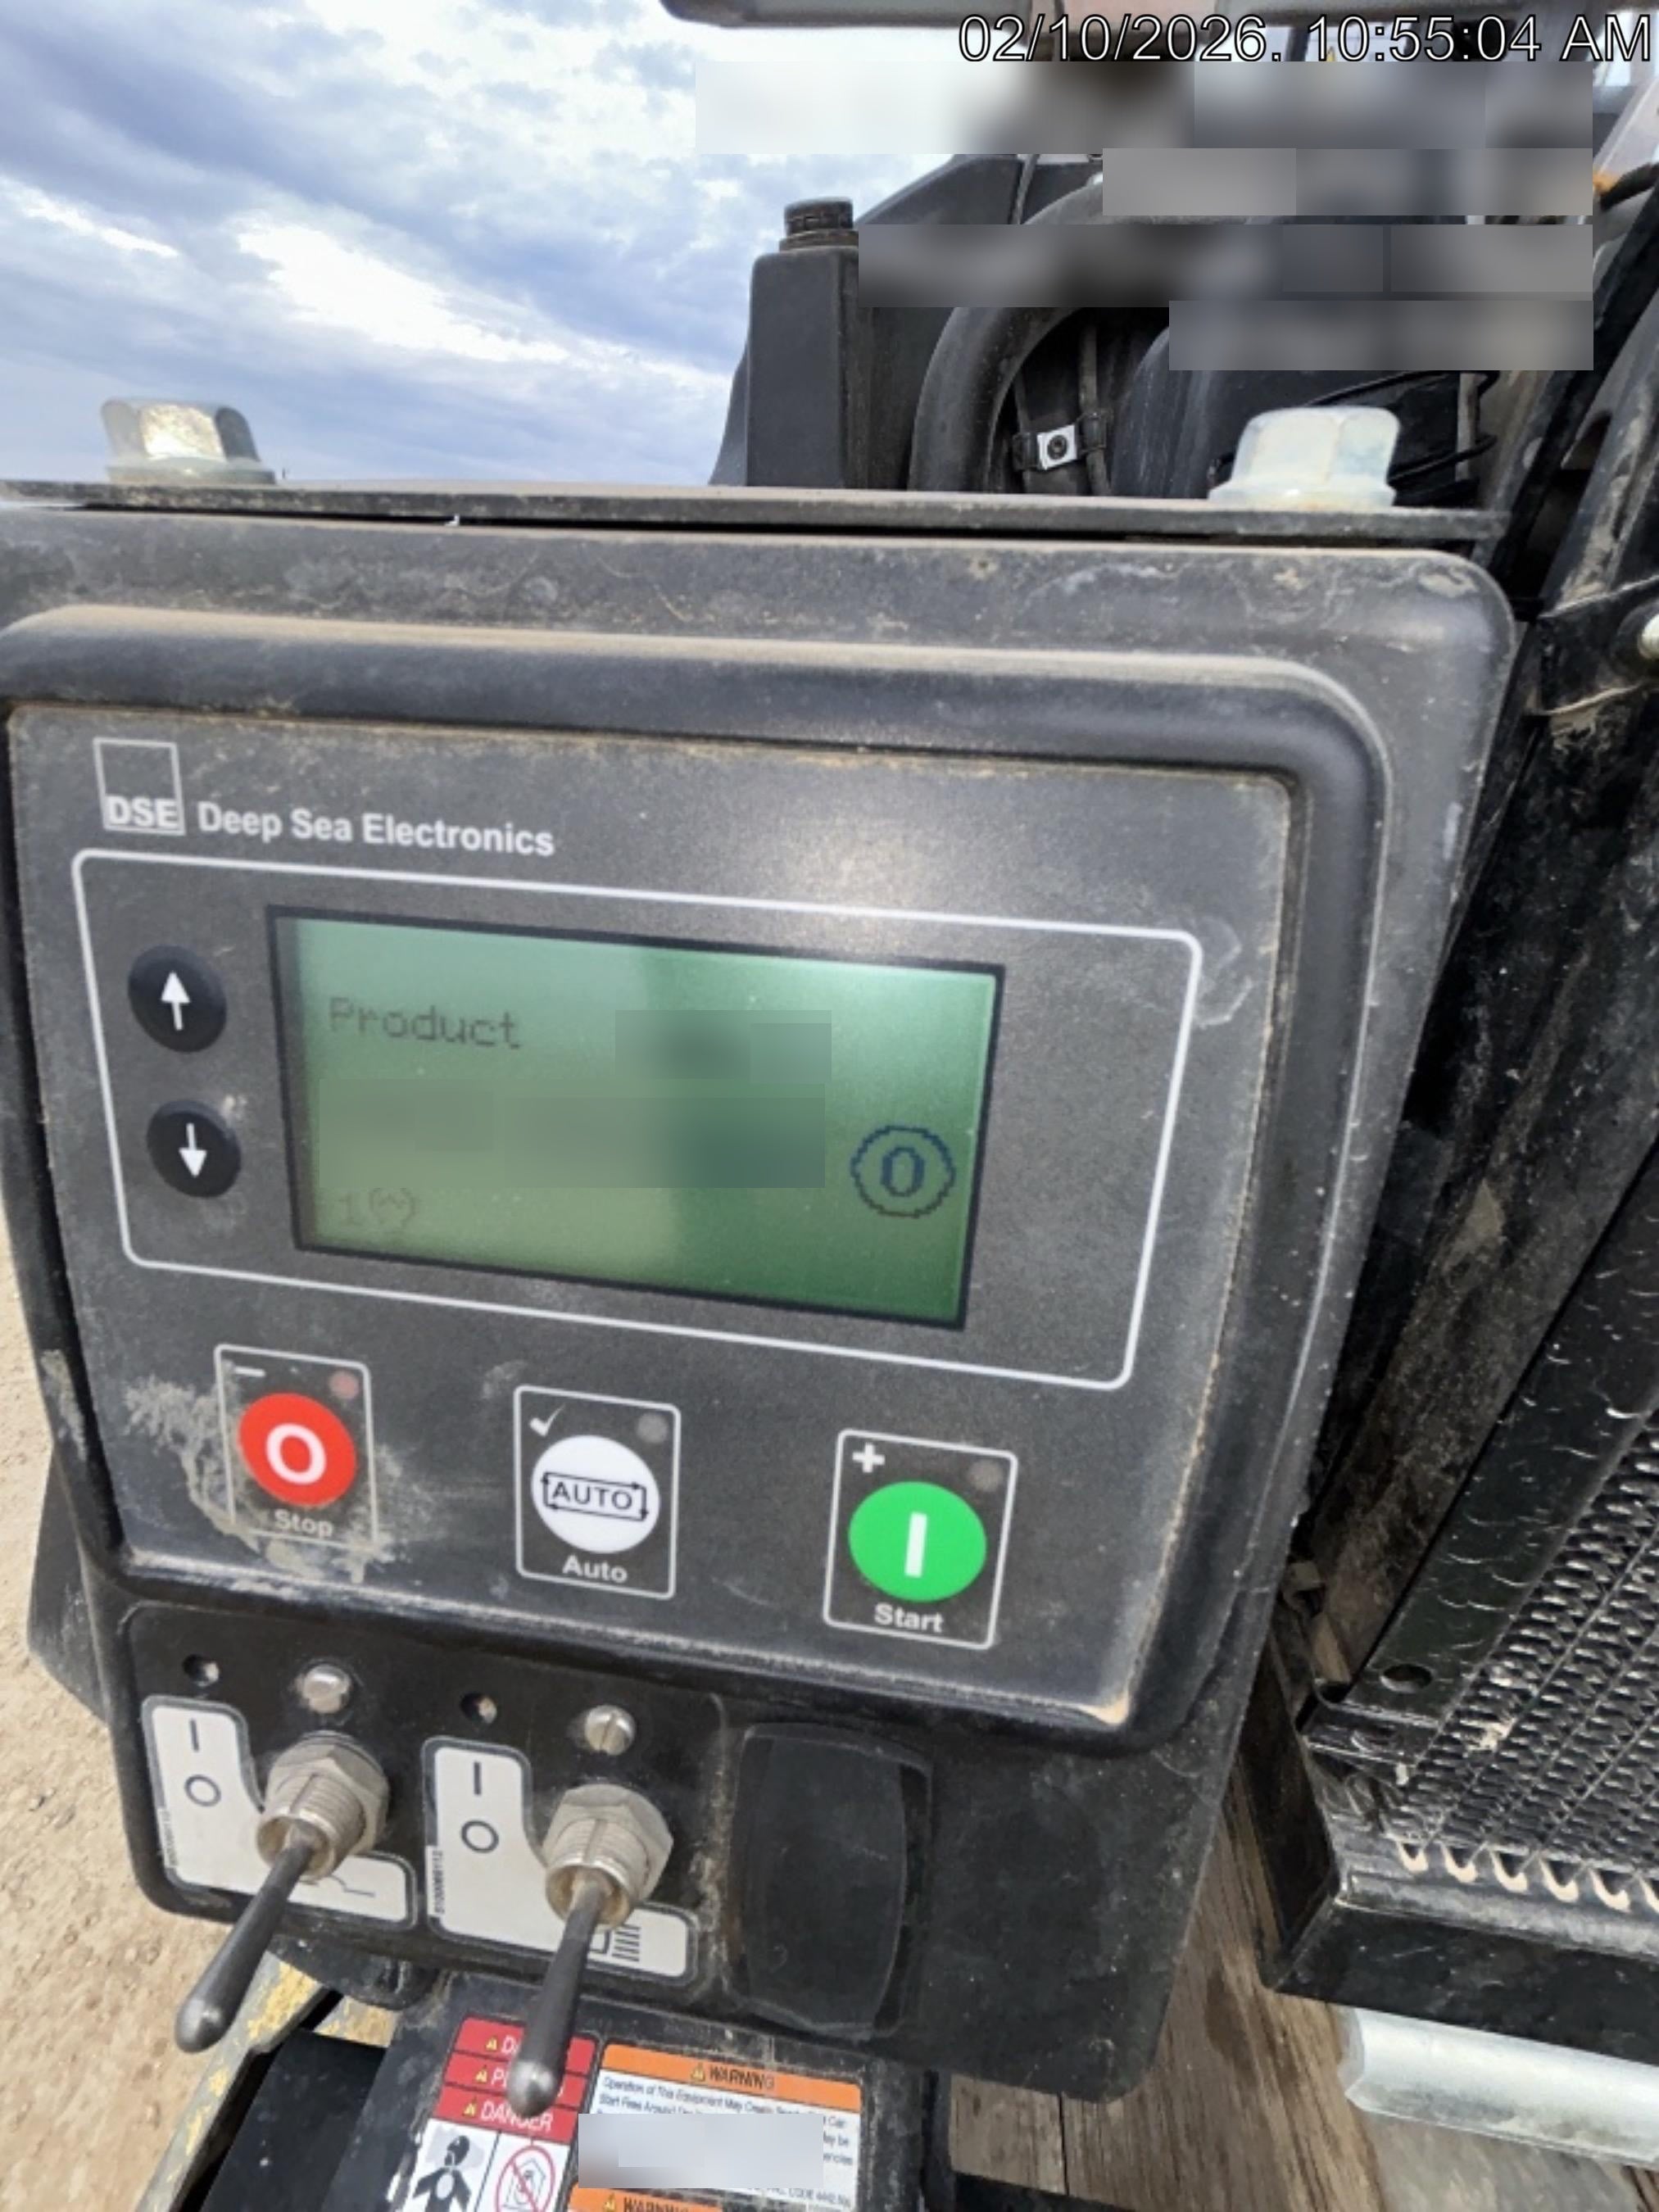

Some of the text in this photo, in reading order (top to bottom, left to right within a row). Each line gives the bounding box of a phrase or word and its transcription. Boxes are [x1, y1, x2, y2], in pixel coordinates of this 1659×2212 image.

[105, 796, 179, 830] DSE
[197, 800, 555, 856] Deep Sea Electronics
[329, 996, 522, 1049] Product
[551, 1481, 634, 1512] AUTO
[272, 1507, 334, 1540] Stop
[561, 1553, 629, 1586] Auto
[873, 1601, 945, 1634] Start
[709, 2065, 774, 2090] WARNING
[623, 2196, 690, 2212] WARN
